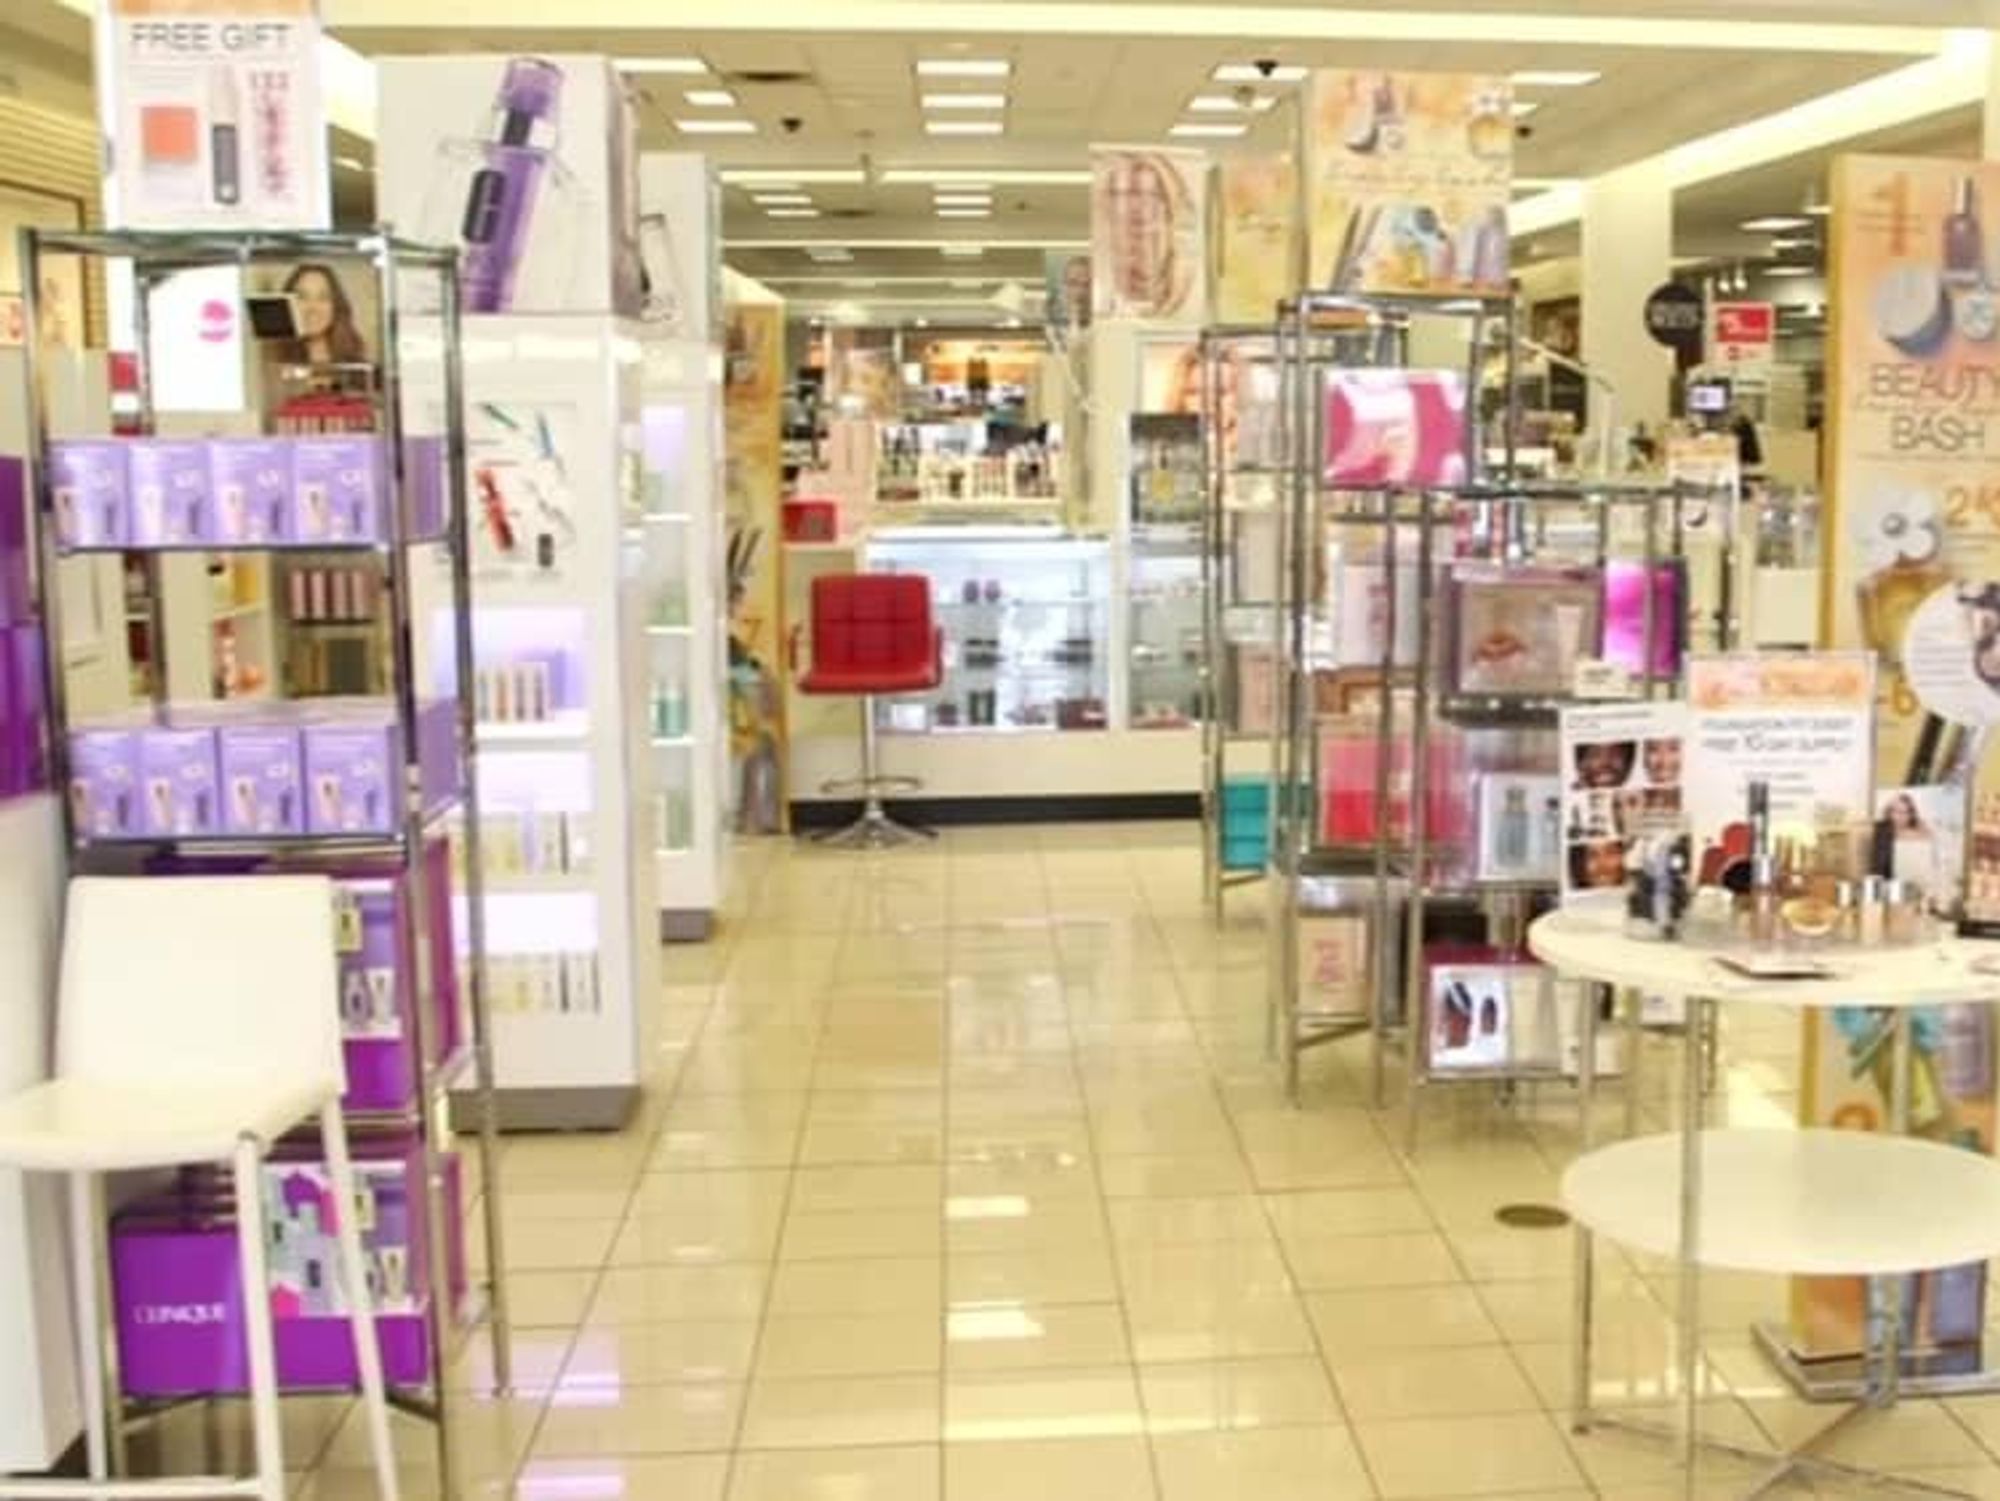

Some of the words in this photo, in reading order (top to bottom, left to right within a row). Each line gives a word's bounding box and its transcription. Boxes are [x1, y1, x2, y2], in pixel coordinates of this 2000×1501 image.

[131, 22, 211, 49] FREE
[220, 22, 294, 50] GIFT
[1890, 415, 1985, 452] BASH
